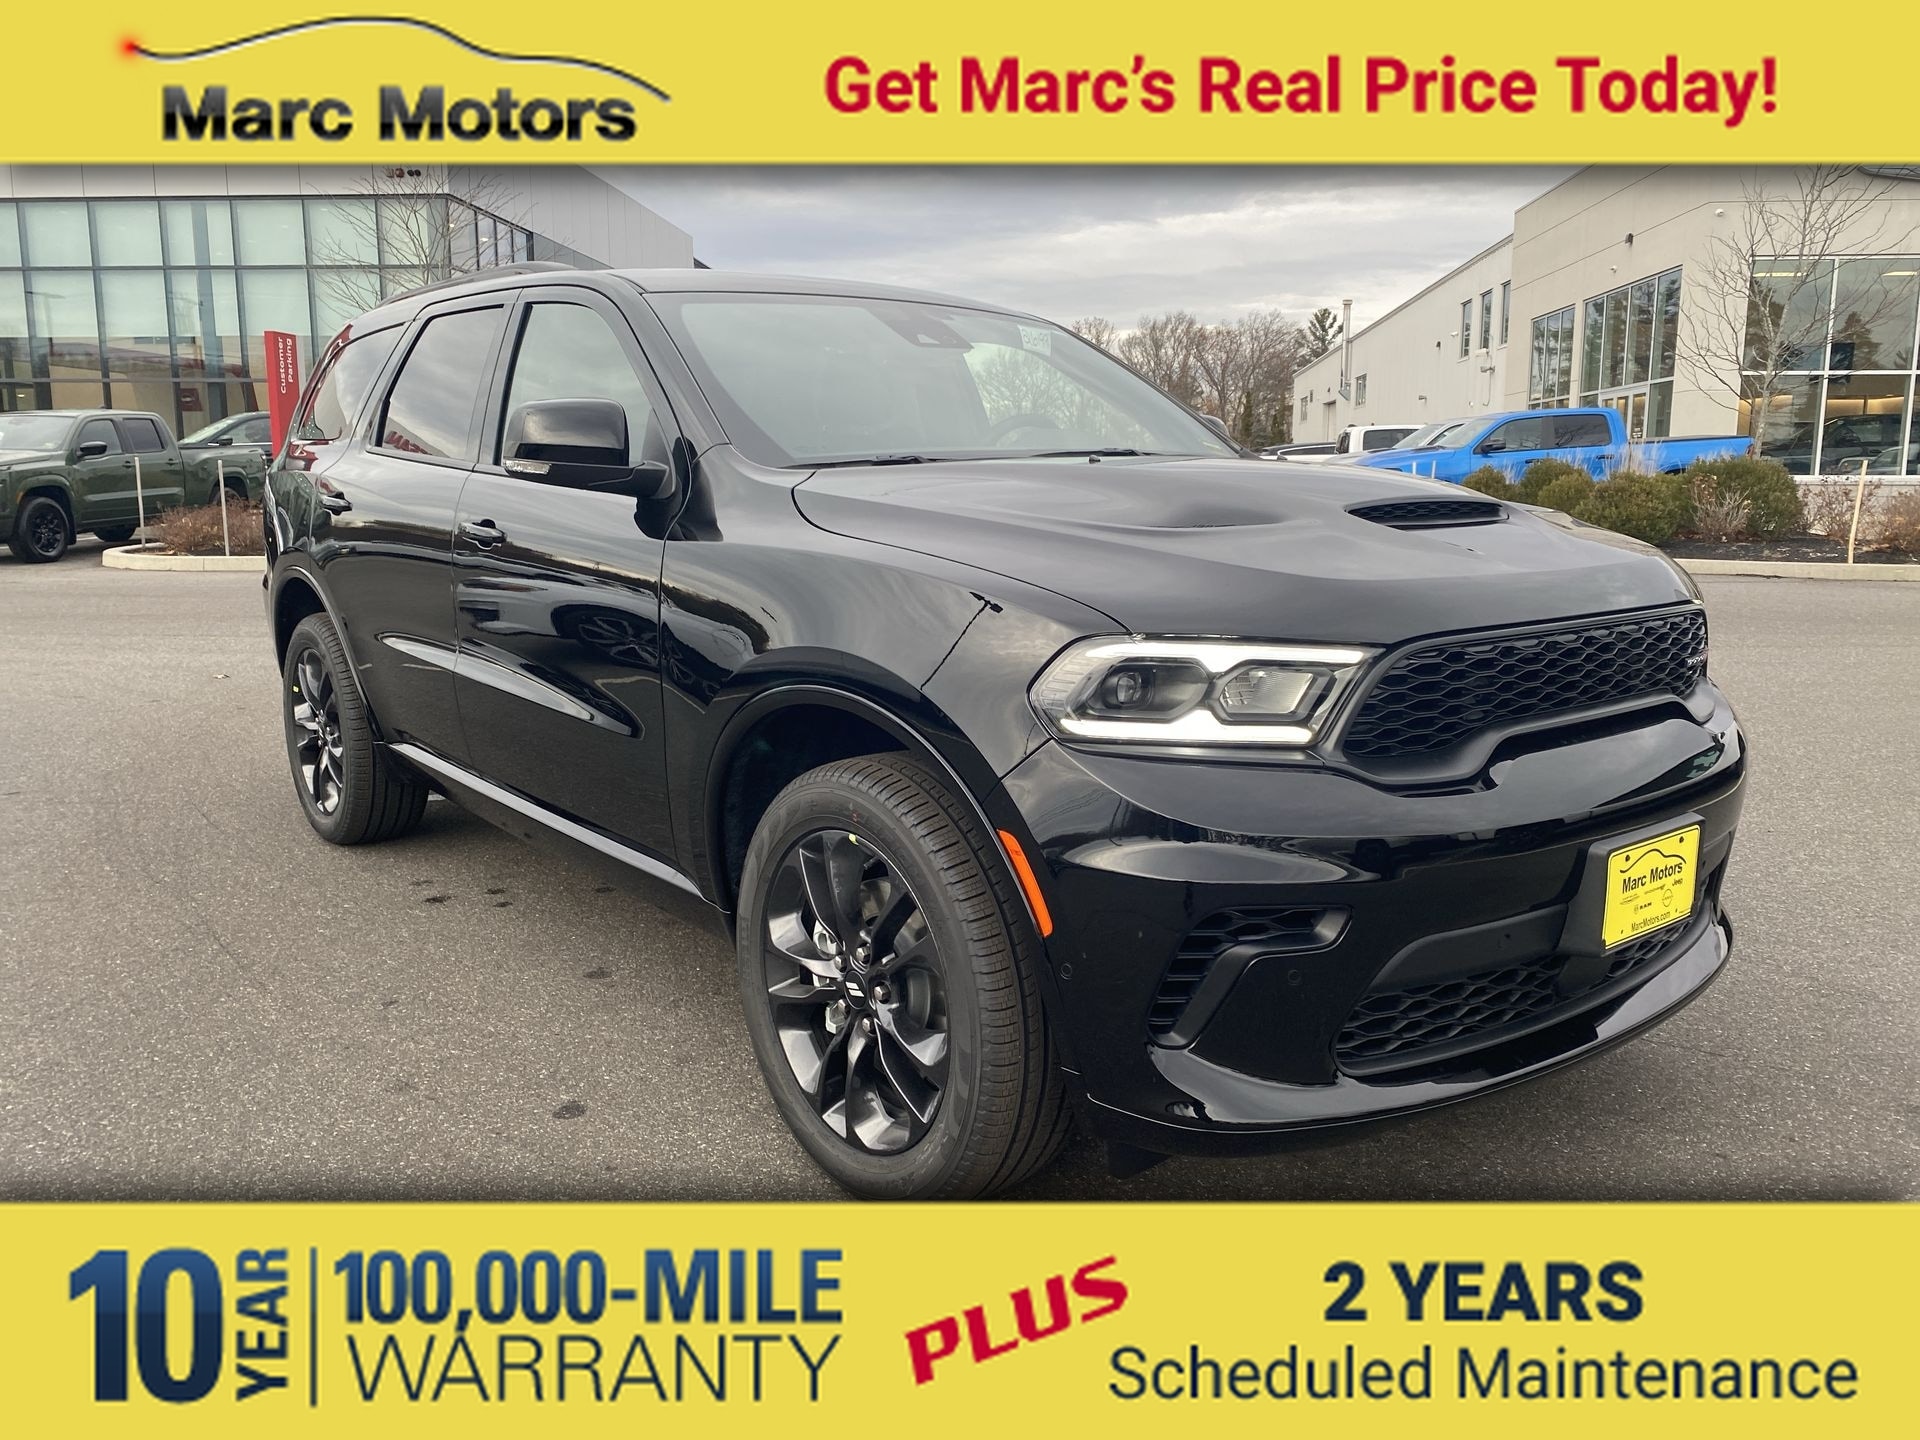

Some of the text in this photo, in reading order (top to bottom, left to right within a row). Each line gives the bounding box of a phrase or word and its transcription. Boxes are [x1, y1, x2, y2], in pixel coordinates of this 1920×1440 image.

[278, 336, 287, 394] Customer
[286, 338, 294, 383] Parking
[1622, 875, 1647, 894] Marc
[1649, 862, 1683, 883] Motors
[1631, 911, 1671, 932] MarcMotors.com
